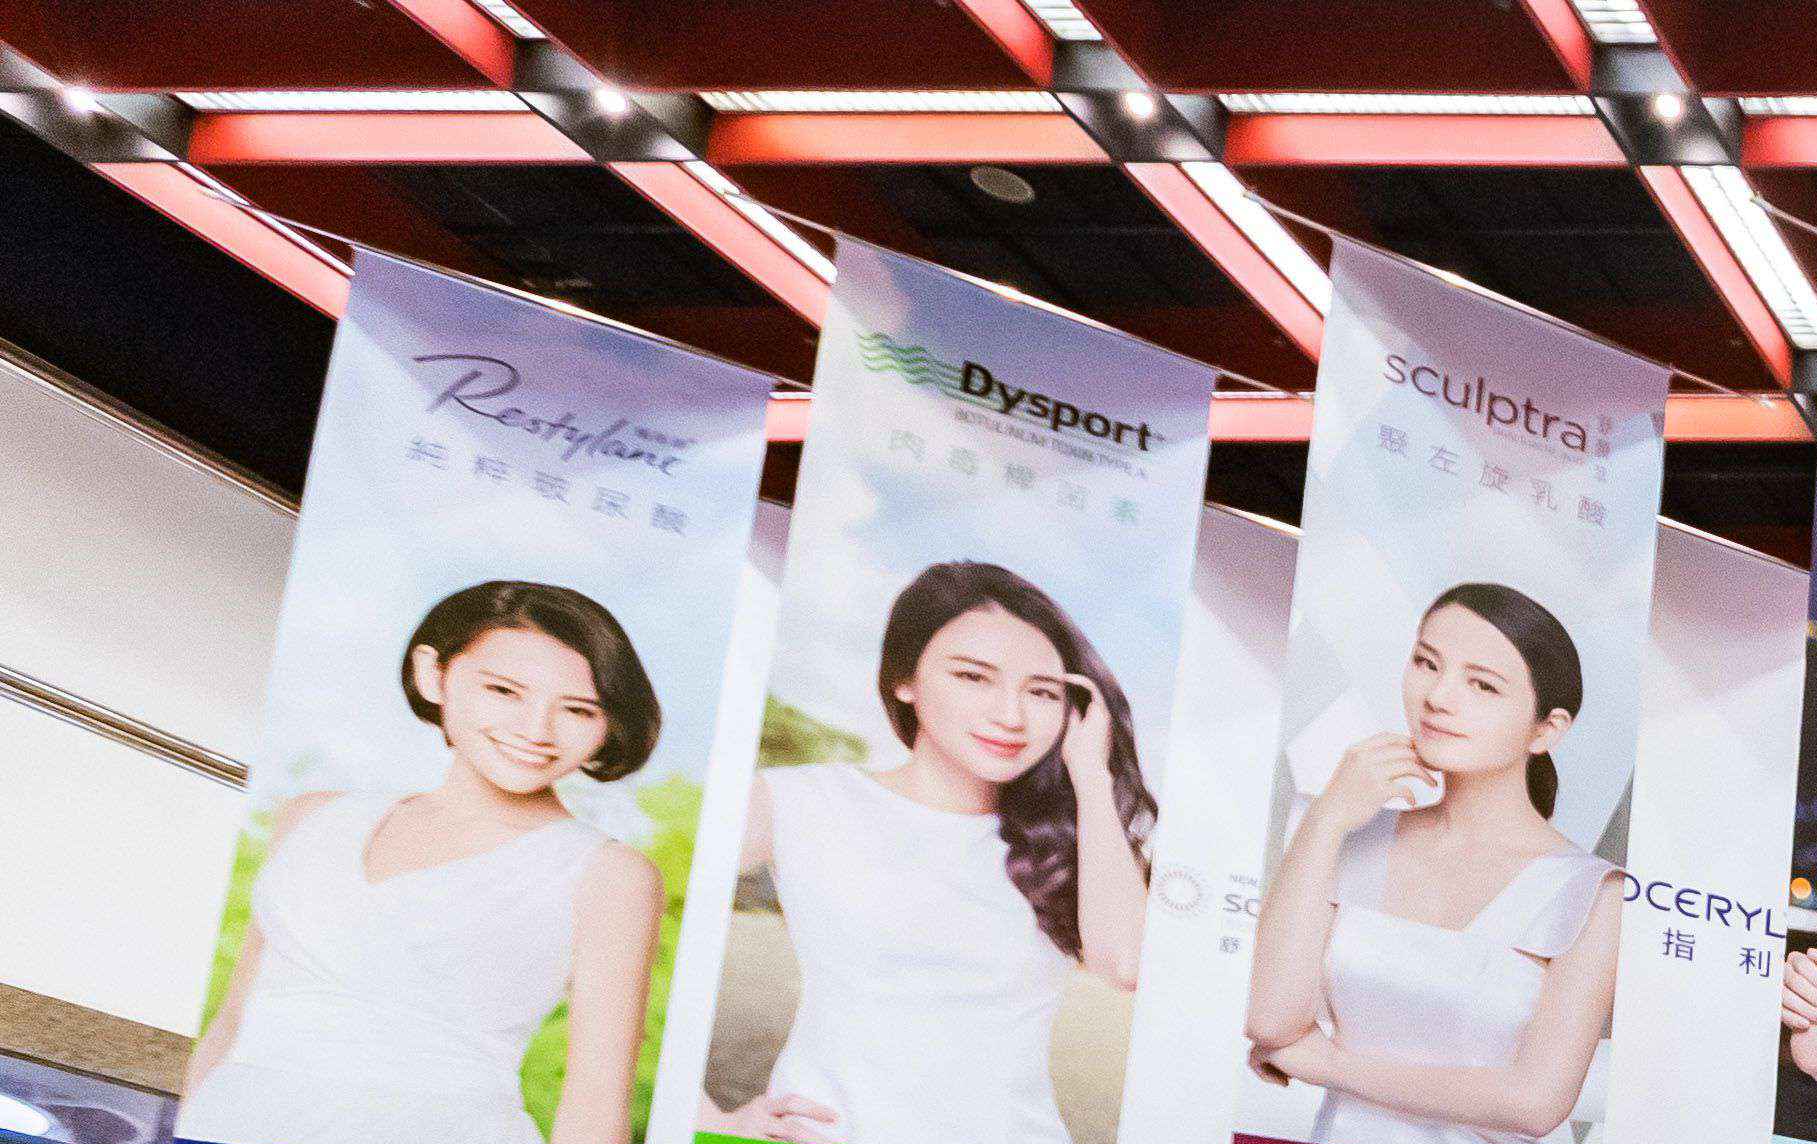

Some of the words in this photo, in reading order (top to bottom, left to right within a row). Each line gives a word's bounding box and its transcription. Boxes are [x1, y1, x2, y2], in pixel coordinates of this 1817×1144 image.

[412, 353, 680, 475] Restylane
[961, 359, 1151, 452] Dysport
[1383, 354, 1587, 452] sculptra
